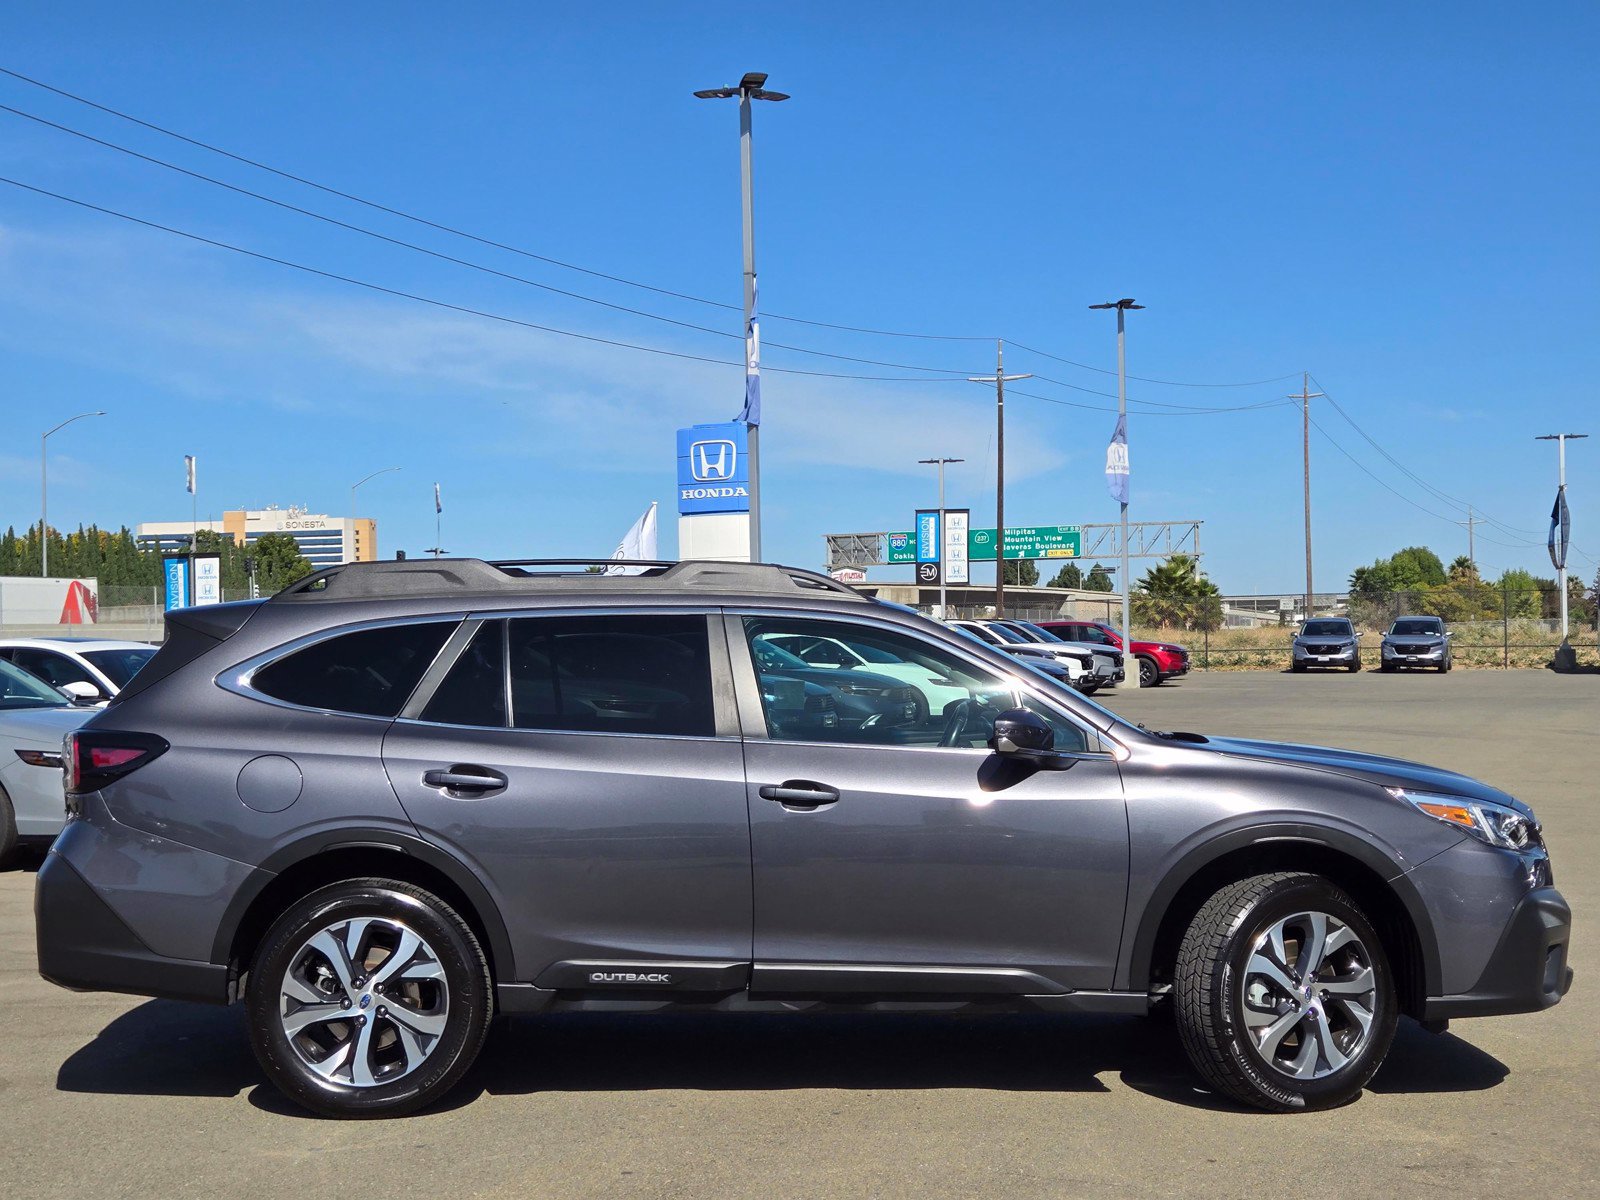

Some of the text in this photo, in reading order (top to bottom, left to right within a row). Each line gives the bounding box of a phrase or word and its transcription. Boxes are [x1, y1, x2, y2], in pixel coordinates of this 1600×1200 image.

[681, 487, 749, 499] HONDA
[285, 521, 326, 529] SONESTA
[891, 539, 907, 547] 880
[921, 516, 930, 559] ENVISION
[169, 563, 179, 609] NVISION
[591, 972, 669, 982] OUTBACK
